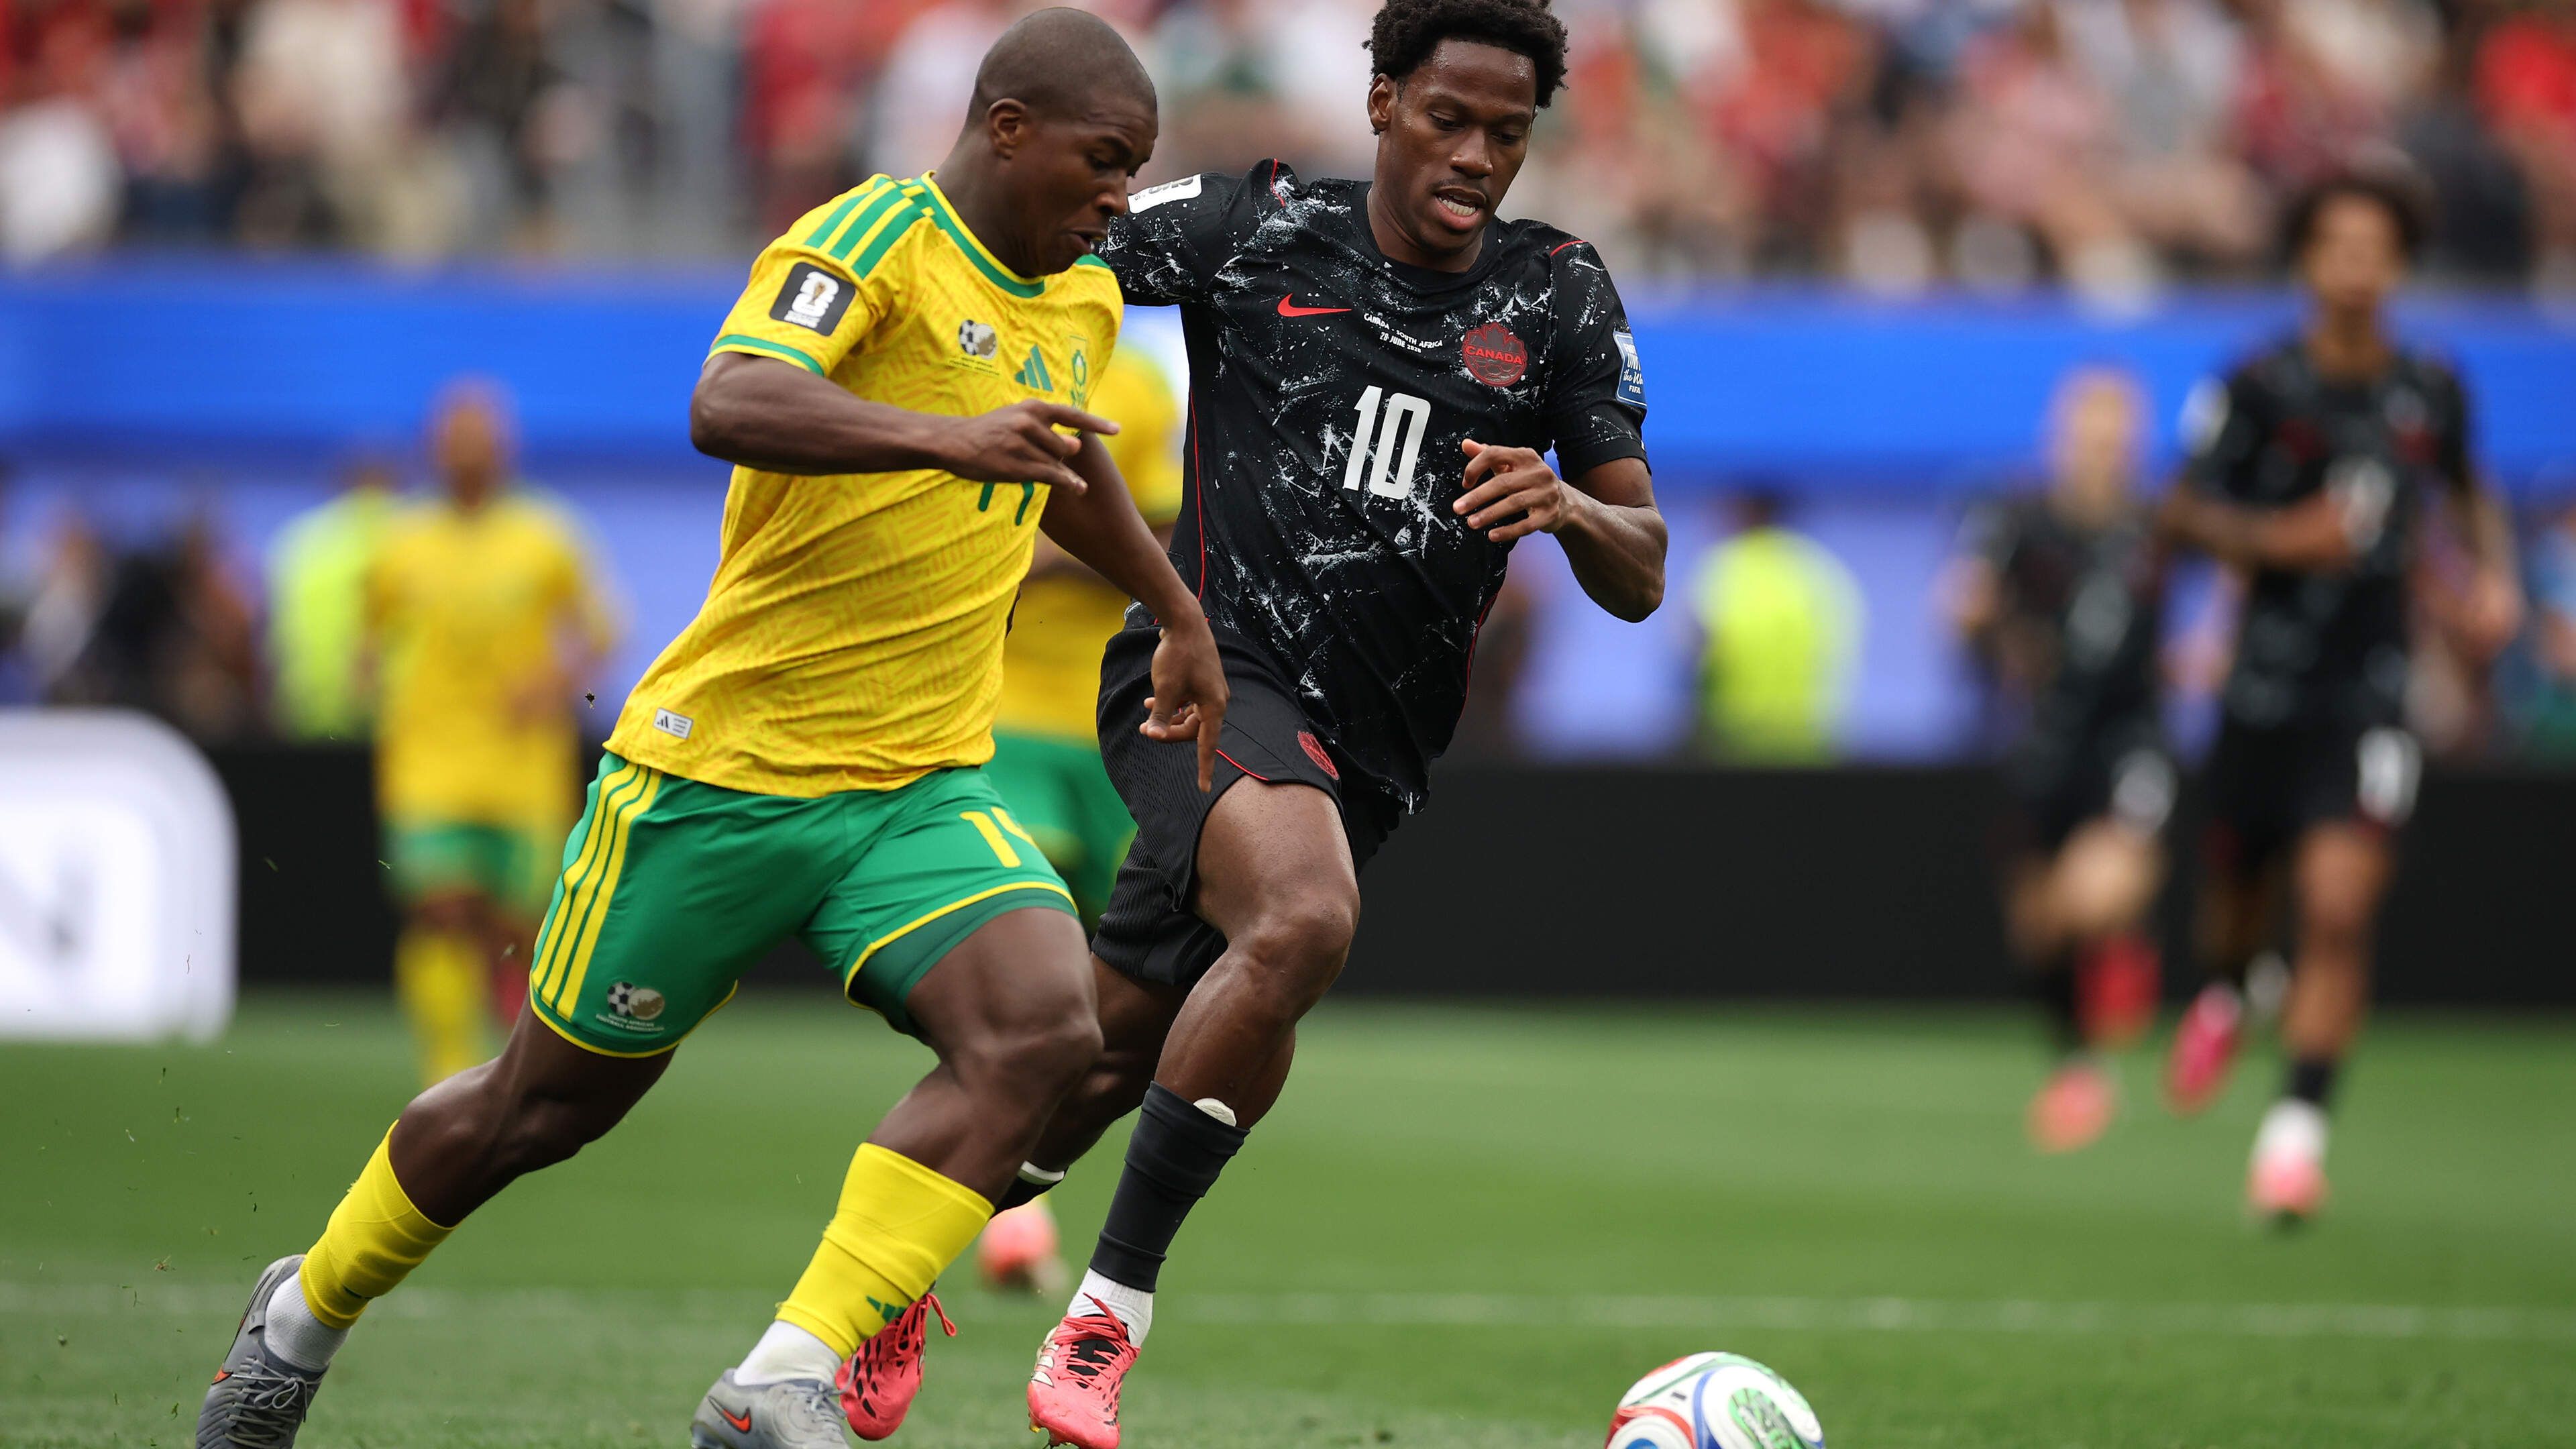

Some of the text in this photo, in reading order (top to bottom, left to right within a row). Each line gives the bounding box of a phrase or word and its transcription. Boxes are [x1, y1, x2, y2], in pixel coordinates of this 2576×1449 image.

[1364, 313, 1390, 329] CANADA
[1396, 329, 1417, 345] SOUTH
[1418, 339, 1443, 349] AFRICA
[1389, 335, 1405, 347] JUNE
[1465, 345, 1523, 365] CANADA
[1628, 384, 1641, 394] FIFA
[1342, 384, 1431, 500] 10
